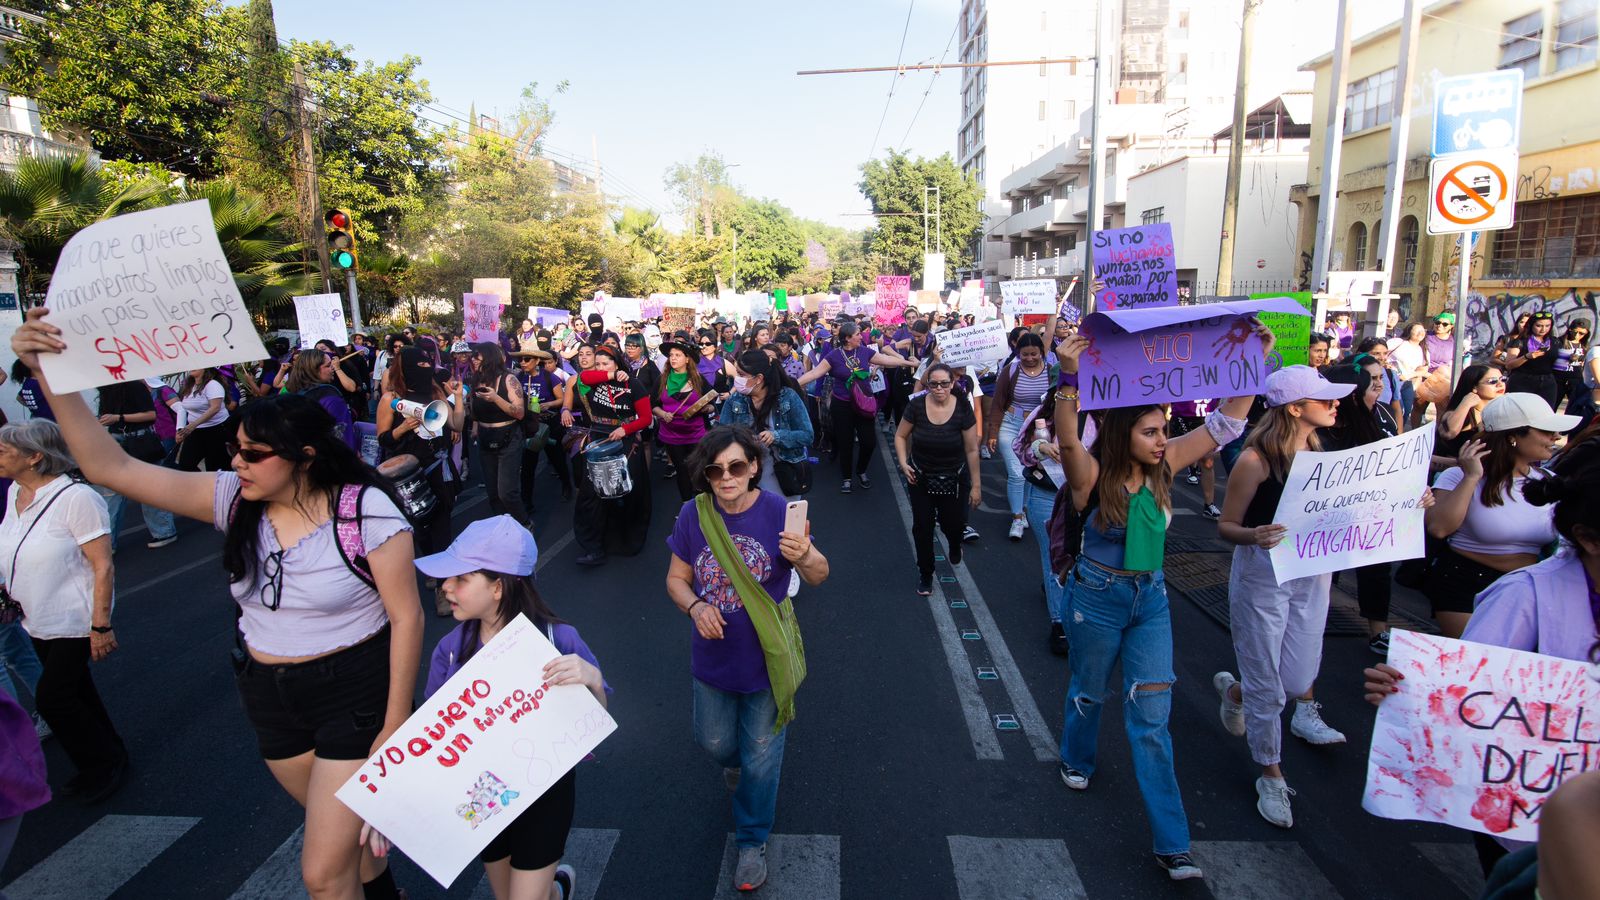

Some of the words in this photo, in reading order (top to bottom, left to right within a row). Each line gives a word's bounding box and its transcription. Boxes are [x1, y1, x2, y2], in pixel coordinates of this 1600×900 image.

[131, 224, 202, 272] quieres
[1119, 231, 1144, 245] no
[1142, 257, 1165, 270] nos
[56, 262, 158, 312] monumentos
[156, 257, 228, 297] limpios
[1105, 272, 1142, 288] matan
[1146, 270, 1173, 291] por
[1018, 296, 1028, 305] NO
[1117, 284, 1168, 310] separado
[69, 314, 98, 336] un
[152, 294, 206, 324] lleno
[211, 289, 239, 314] de
[1141, 332, 1193, 364] DIA
[1091, 373, 1121, 401] UN
[1140, 367, 1184, 397] DES
[1192, 365, 1219, 387] ME
[1229, 355, 1260, 391] NO
[1302, 433, 1433, 492] AGRADEZCAN
[1304, 497, 1330, 513] QUE
[1332, 489, 1388, 509] QUEREMOS
[1390, 502, 1399, 513] Y
[1401, 498, 1414, 510] NO
[1296, 517, 1395, 559] VENGANZA
[1458, 691, 1600, 744] CALL
[1507, 799, 1543, 829] M
